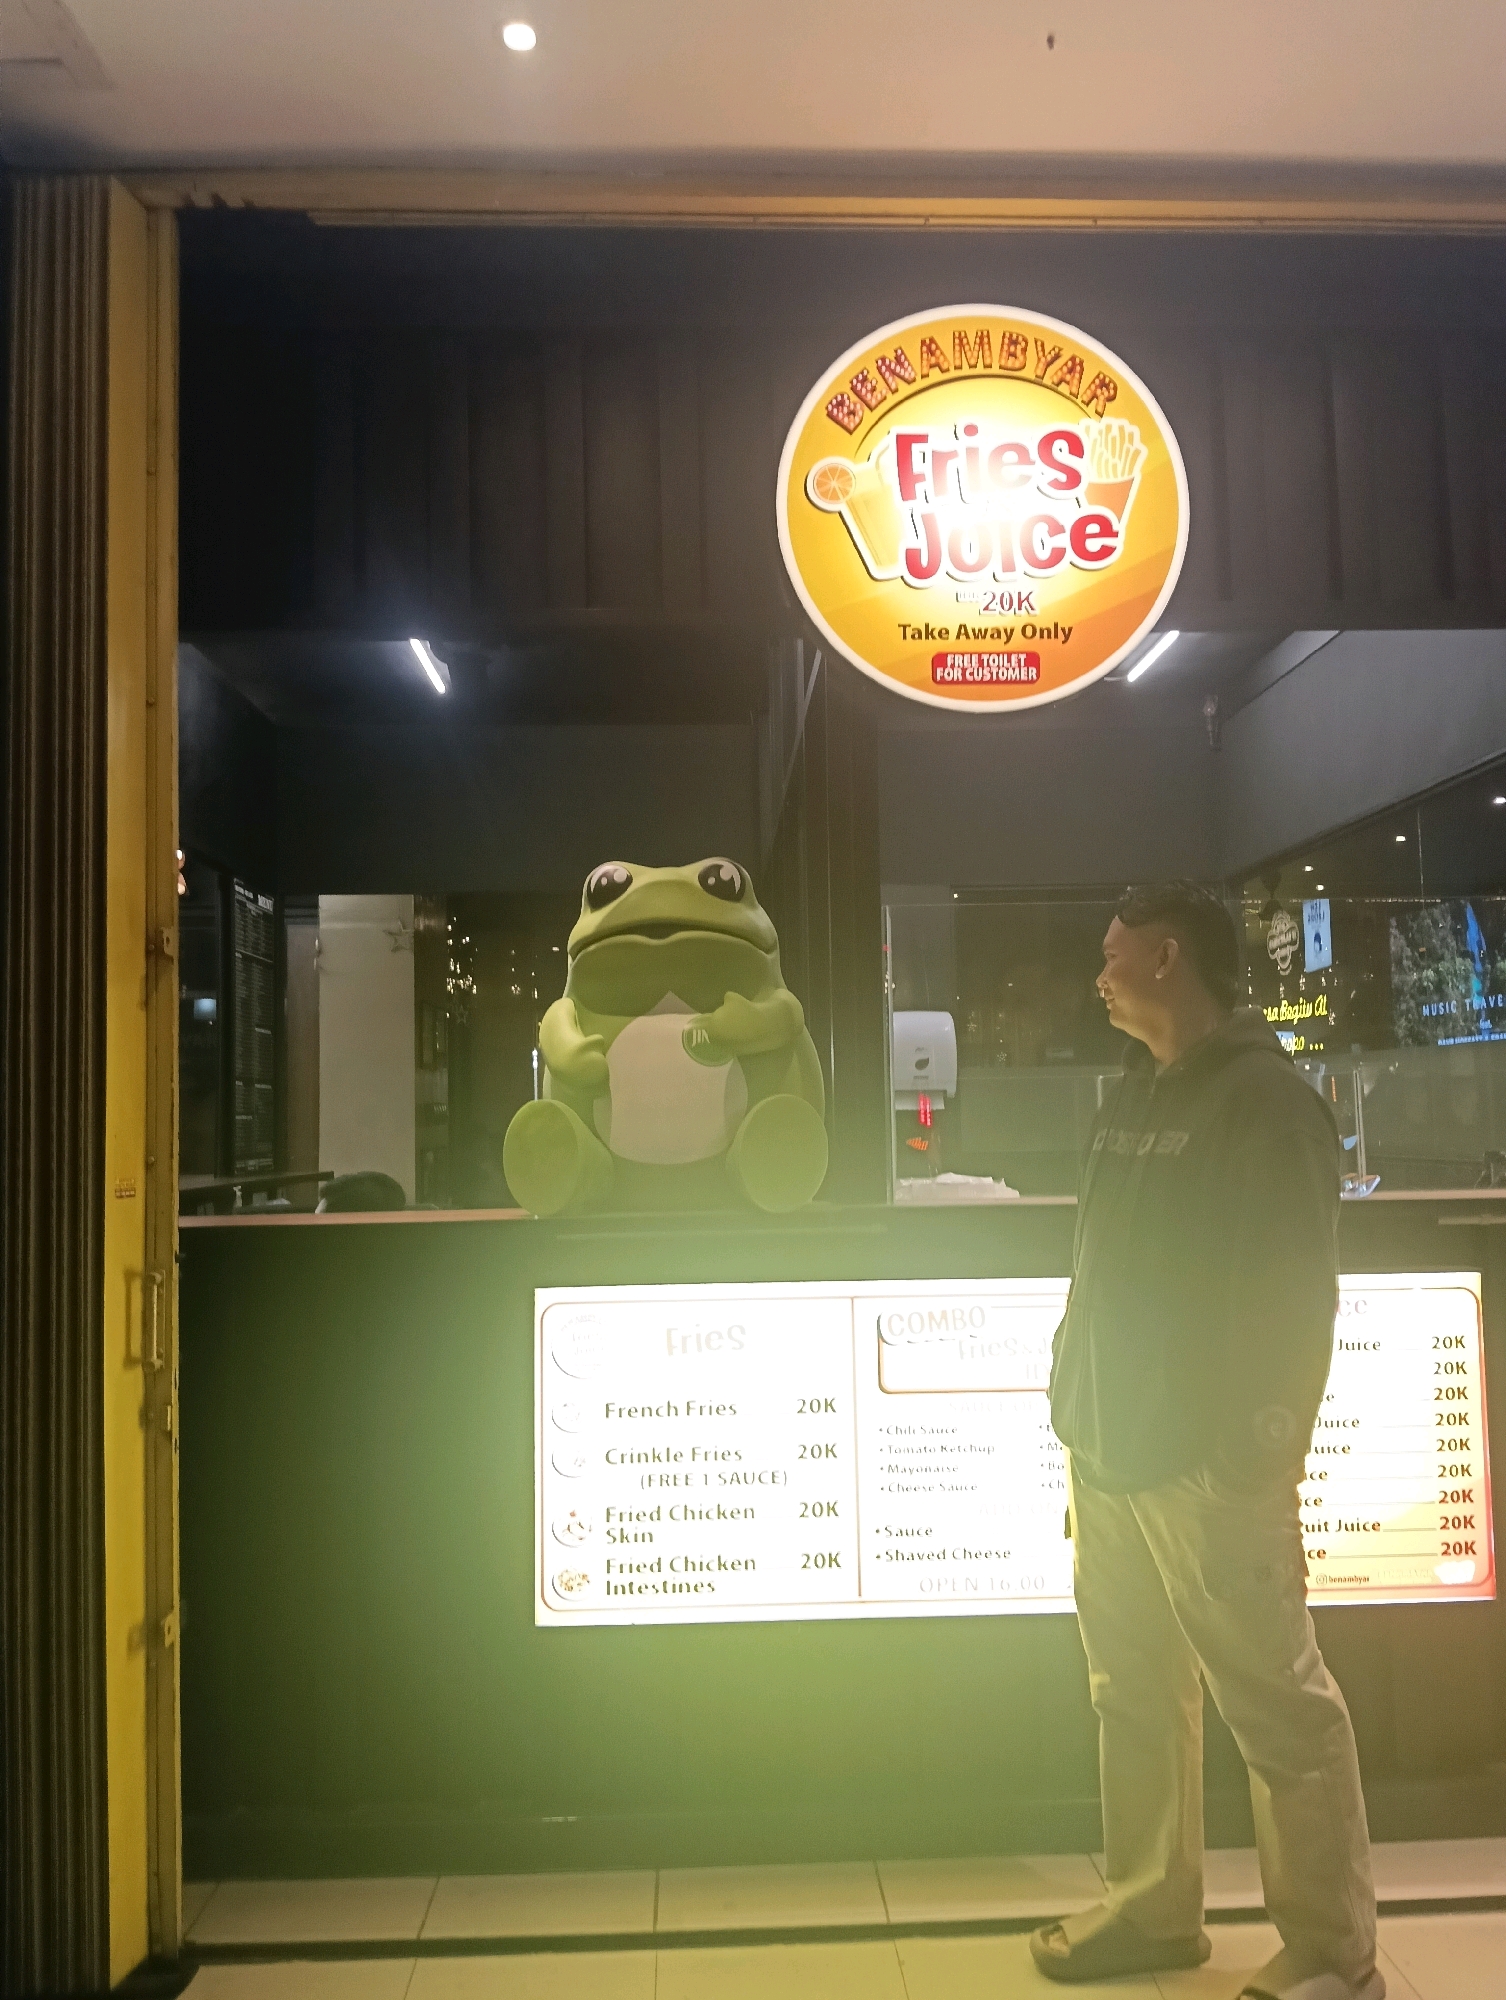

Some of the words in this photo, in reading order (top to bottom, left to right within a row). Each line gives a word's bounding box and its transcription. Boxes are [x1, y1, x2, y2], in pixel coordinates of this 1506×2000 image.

[825, 329, 1118, 435] BENAMBYAR
[905, 512, 1119, 580] Juice
[982, 590, 1036, 612] 20K
[898, 623, 950, 642] Take
[955, 623, 1015, 646] Away
[1021, 621, 1073, 644] Only
[946, 653, 979, 668] FREE
[981, 653, 1026, 668] TOILET
[936, 667, 963, 681] FOR
[965, 666, 1037, 681] CUSTOMER
[1422, 1000, 1457, 1017] MUSIC
[887, 1306, 986, 1337] COMBO
[1338, 1338, 1382, 1351] Juice
[1431, 1335, 1466, 1350] 20K
[1433, 1361, 1468, 1375] 20K
[1433, 1386, 1469, 1401] 20K
[605, 1401, 678, 1419] French
[686, 1399, 737, 1416] Fries
[796, 1398, 836, 1414] 20K
[1434, 1412, 1470, 1427] 20K
[920, 1423, 958, 1435] Sauce
[605, 1447, 683, 1465] Crinkle
[691, 1446, 742, 1462] Fries
[797, 1443, 838, 1459] 20K
[887, 1444, 936, 1455] Tomato
[940, 1443, 995, 1456] Ketchup
[1314, 1442, 1351, 1455] uice
[1436, 1438, 1472, 1452] 20K
[887, 1463, 959, 1475] Mayonaise
[1437, 1464, 1473, 1478] 20K
[640, 1472, 694, 1489] (FREE
[717, 1470, 787, 1488] SAUCE)
[888, 1481, 935, 1493] Cheese
[940, 1481, 978, 1492] Sauce
[1438, 1489, 1475, 1504] 20K
[605, 1505, 661, 1523] Fried
[669, 1503, 755, 1520] Chicken
[799, 1501, 839, 1518] 20K
[884, 1525, 933, 1538] Sauce
[1336, 1518, 1381, 1533] Juice
[1439, 1515, 1476, 1530] 20K
[605, 1528, 654, 1544] Skin
[885, 1547, 946, 1563] Shaved
[952, 1547, 1012, 1561] Cheese
[1440, 1542, 1478, 1557] 20K
[605, 1556, 662, 1574] Fried
[669, 1555, 756, 1572] Chicken
[801, 1553, 842, 1569] 20K
[606, 1578, 716, 1595] Intestines
